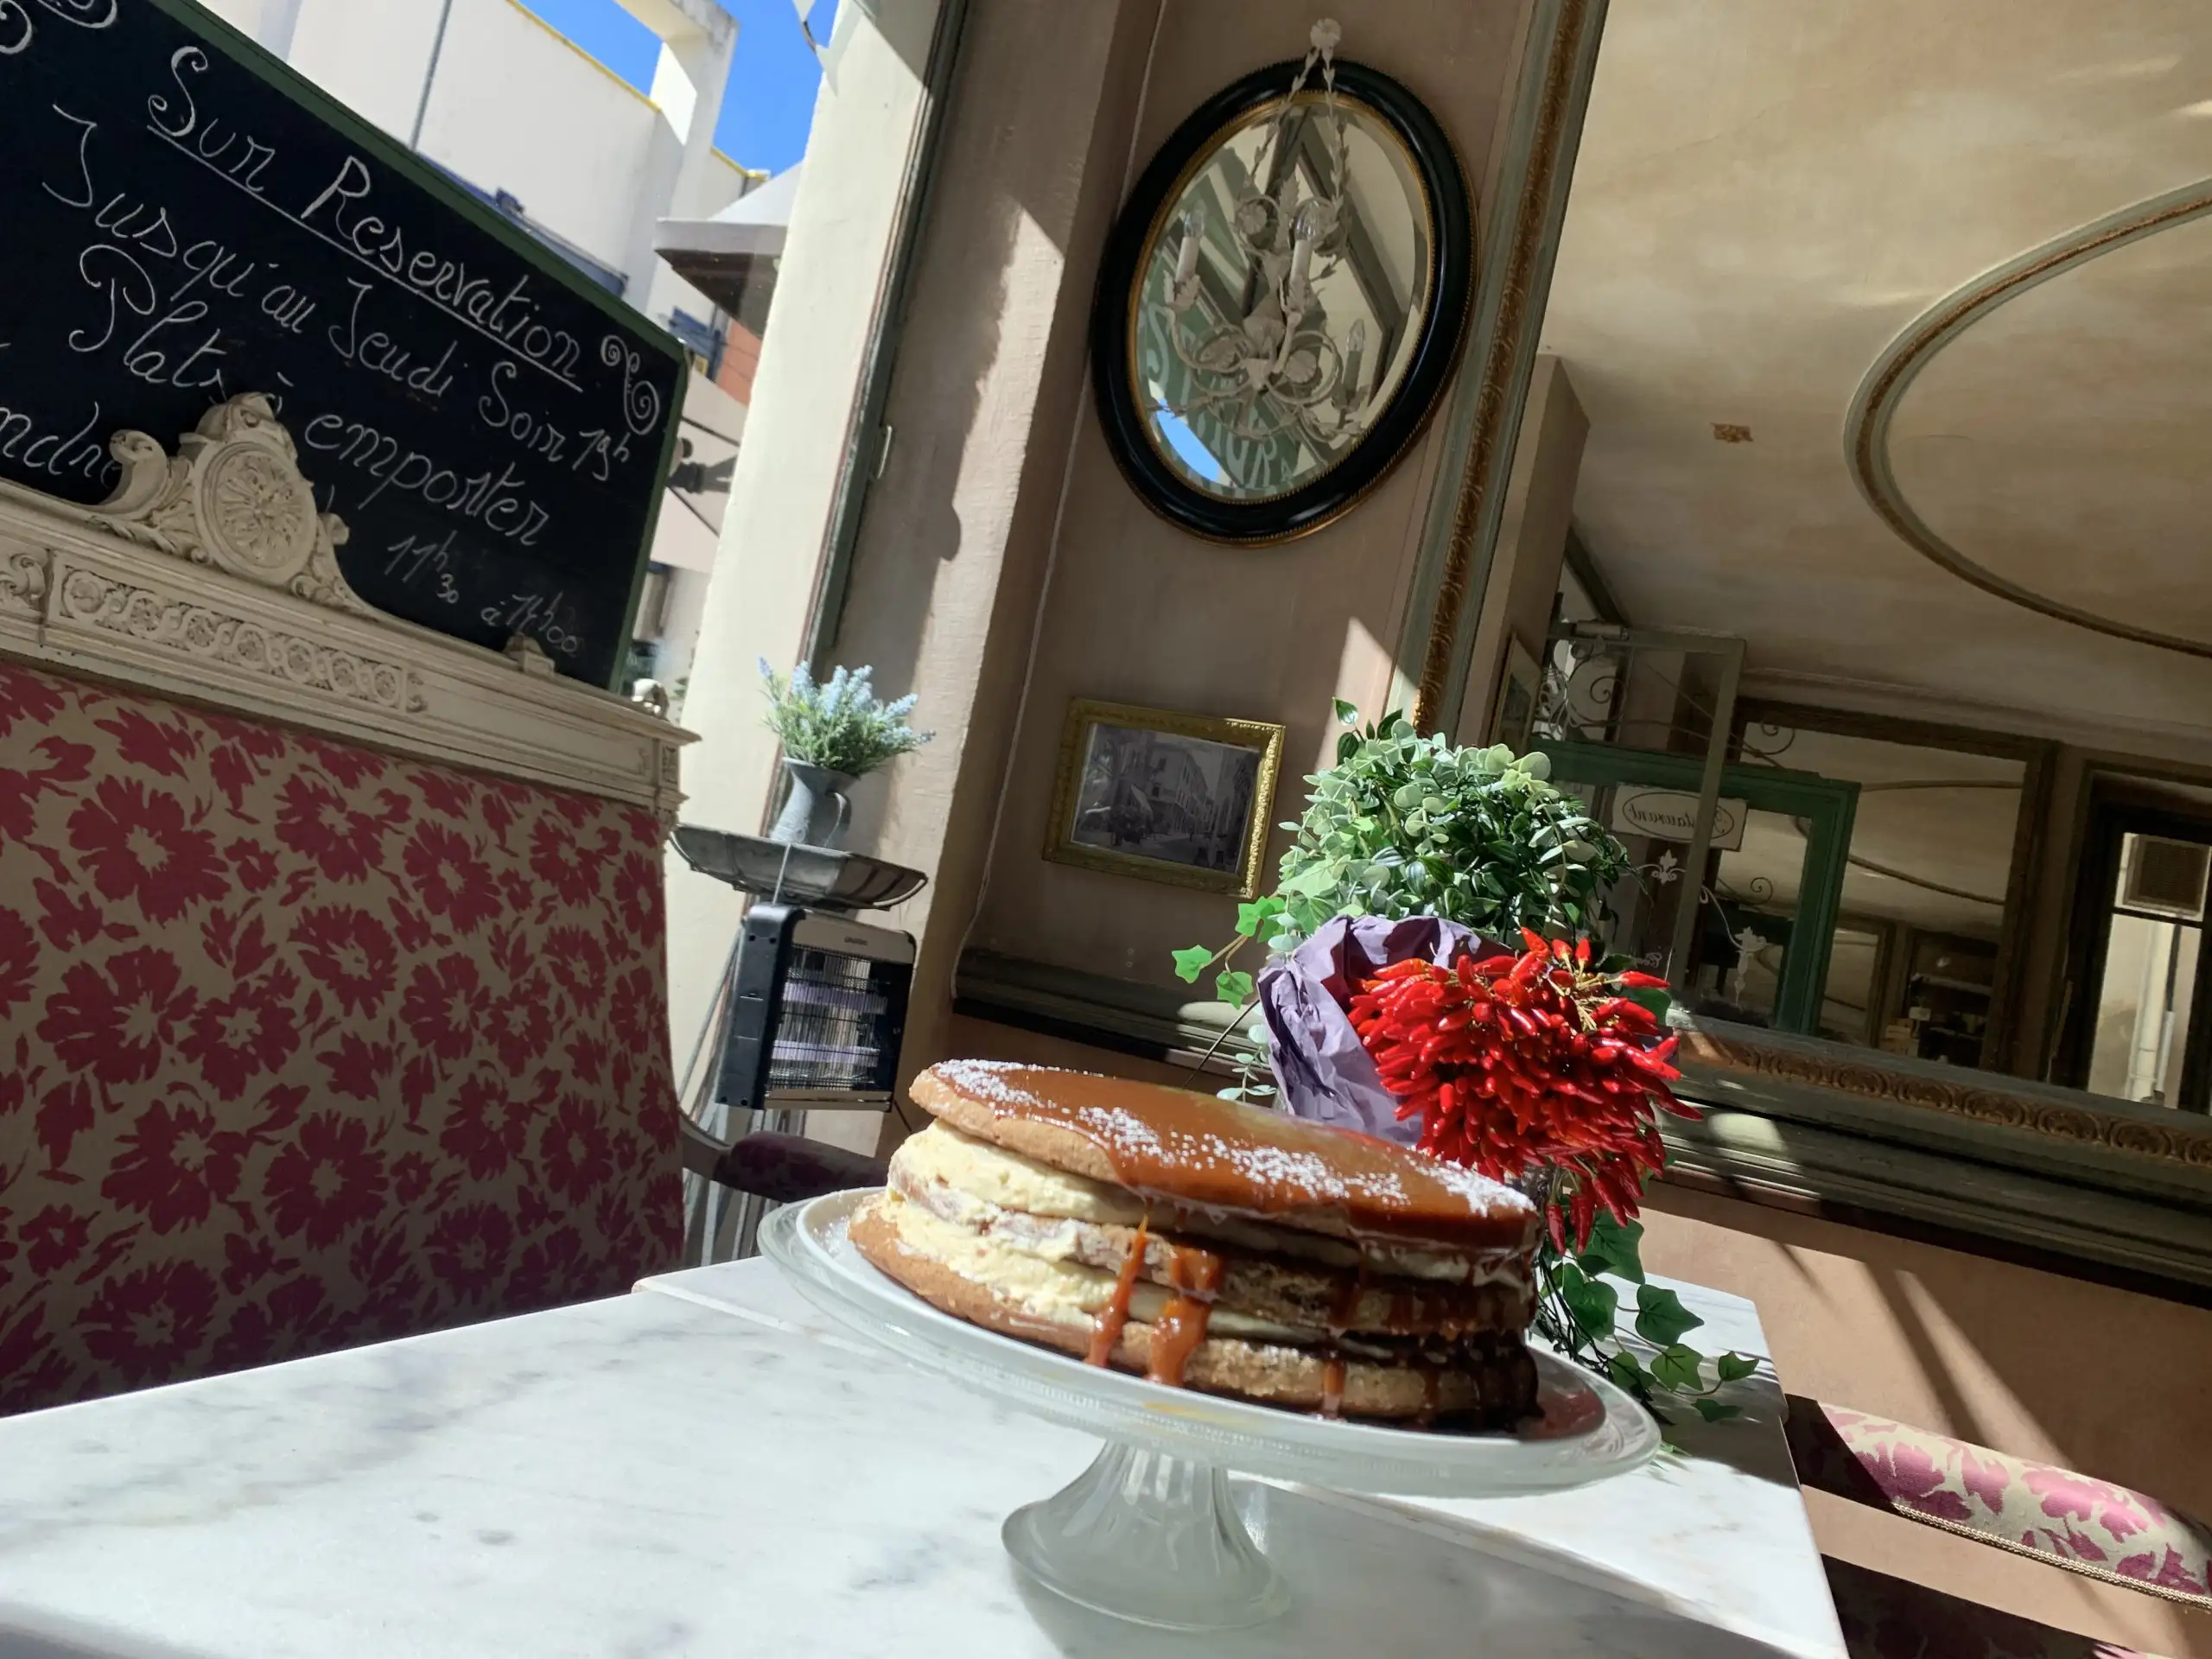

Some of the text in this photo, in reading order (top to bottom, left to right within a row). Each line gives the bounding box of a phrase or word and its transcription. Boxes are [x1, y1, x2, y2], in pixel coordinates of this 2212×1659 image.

[148, 46, 577, 378] Sur Reservation
[68, 245, 550, 546] Plats emporter
[327, 276, 469, 397] Jeudi
[479, 361, 567, 461] Soir
